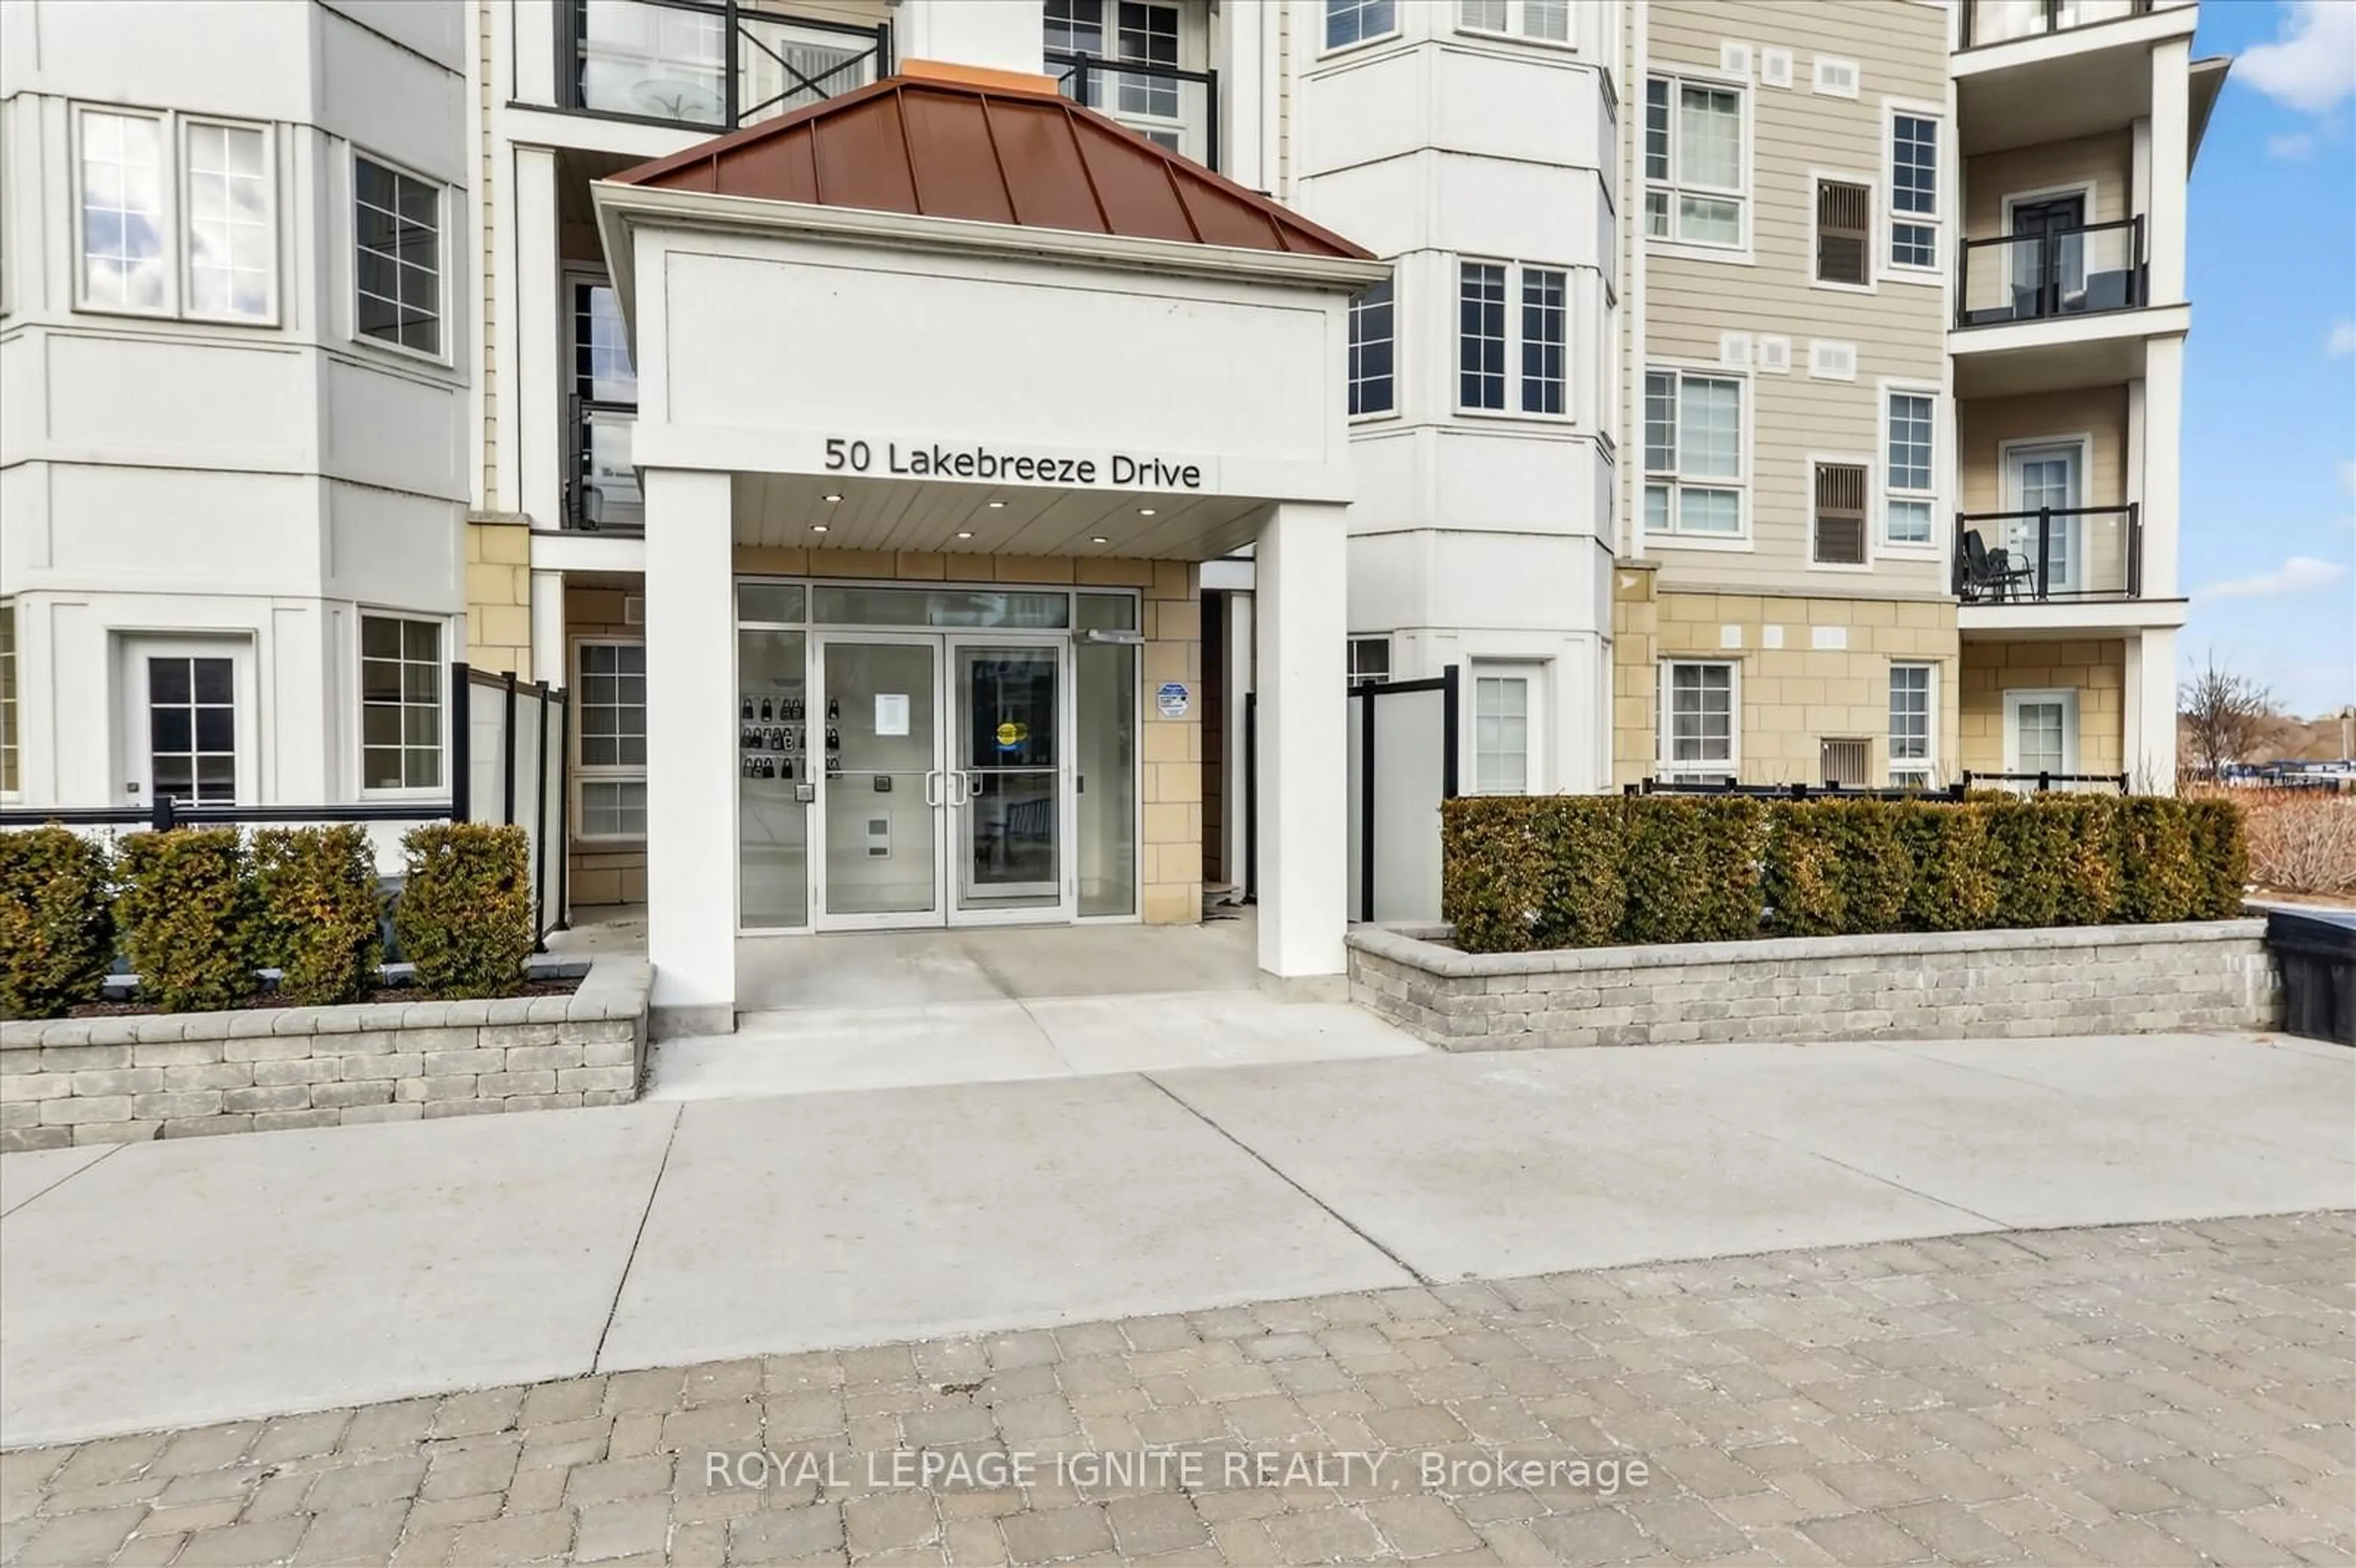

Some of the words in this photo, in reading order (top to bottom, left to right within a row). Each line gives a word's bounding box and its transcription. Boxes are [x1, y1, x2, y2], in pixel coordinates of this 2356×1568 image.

[825, 438, 870, 472] 50
[889, 443, 1096, 483] Lakebreeze
[1112, 455, 1201, 488] Drive
